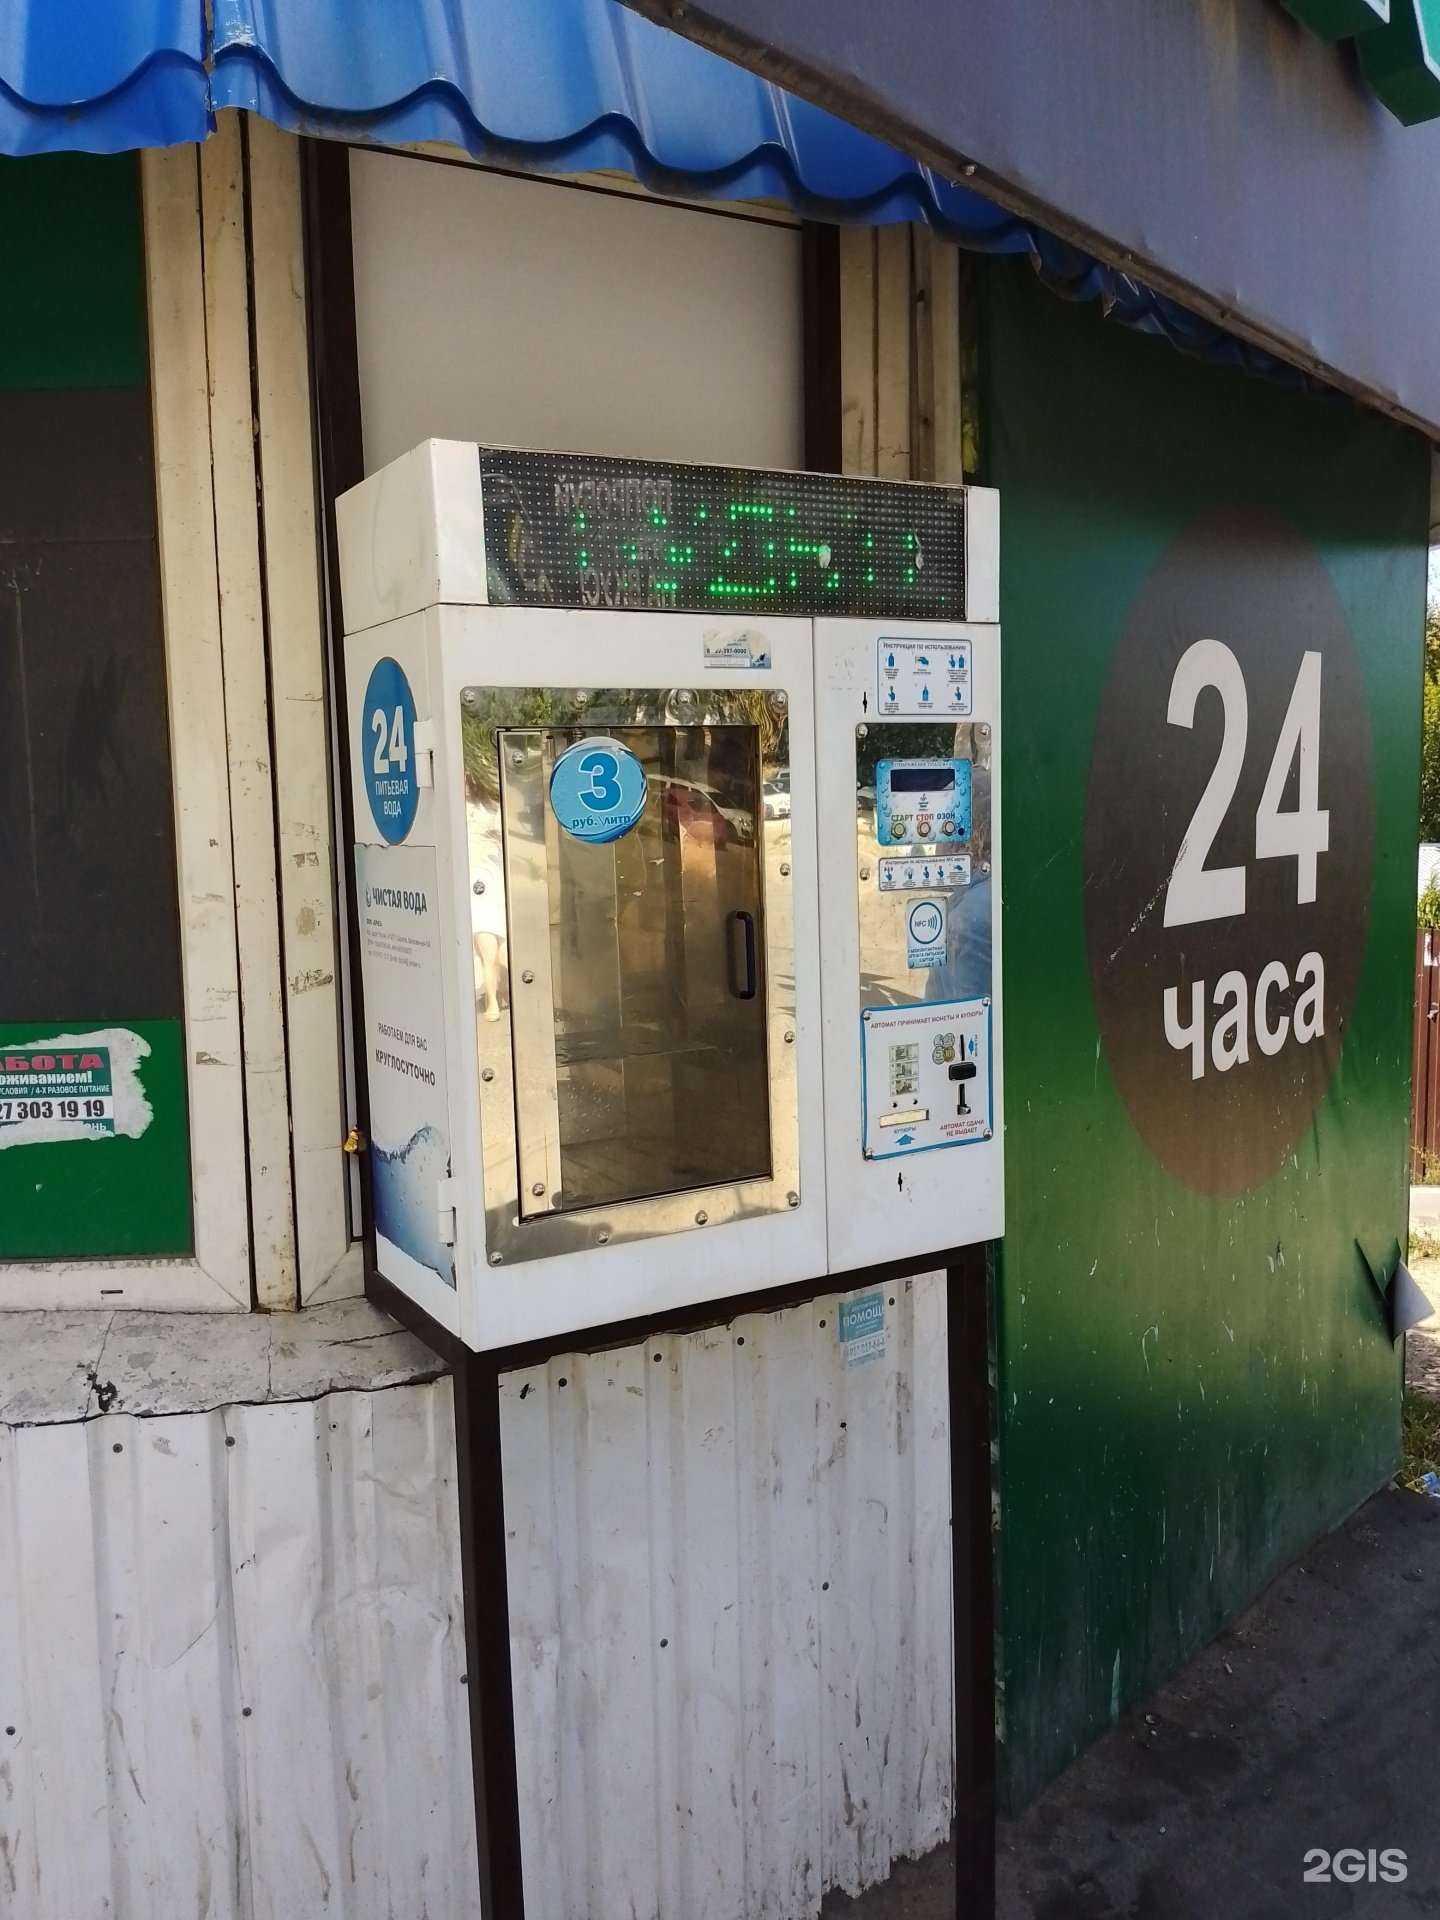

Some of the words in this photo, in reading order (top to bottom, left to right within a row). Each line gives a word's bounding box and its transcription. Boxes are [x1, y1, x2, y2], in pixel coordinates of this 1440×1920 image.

[371, 705, 408, 774] 24
[375, 780, 409, 796] ПИТЬЕВАЯ
[578, 751, 622, 812] 3
[1163, 638, 1330, 928] 24
[383, 801, 402, 818] ВОДА
[916, 813, 934, 821] СТОП
[936, 812, 956, 820] ОЗОН
[372, 887, 402, 909] ЧИСТАЯ
[403, 891, 427, 915] ВОДА
[870, 1020, 897, 1029] АВТОМАТ
[897, 1017, 932, 1027] ПРИНИМАЕТ
[931, 1014, 955, 1023] МОНЕТЫ
[1163, 951, 1326, 1081] часа
[378, 1022, 404, 1041] РАБОТАЕМ
[404, 1031, 416, 1046] ДЛЯ
[416, 1035, 428, 1051] ВАС
[0, 1053, 104, 1071] БОТА
[375, 1048, 436, 1086] КРУГЛОСУТОЧНО
[47, 1086, 78, 1094] РАЗОВОЕ
[79, 1084, 110, 1093] ПИТАНИЕ
[17, 1101, 53, 1119] 303
[57, 1100, 79, 1118] 19
[83, 1099, 105, 1117] 19
